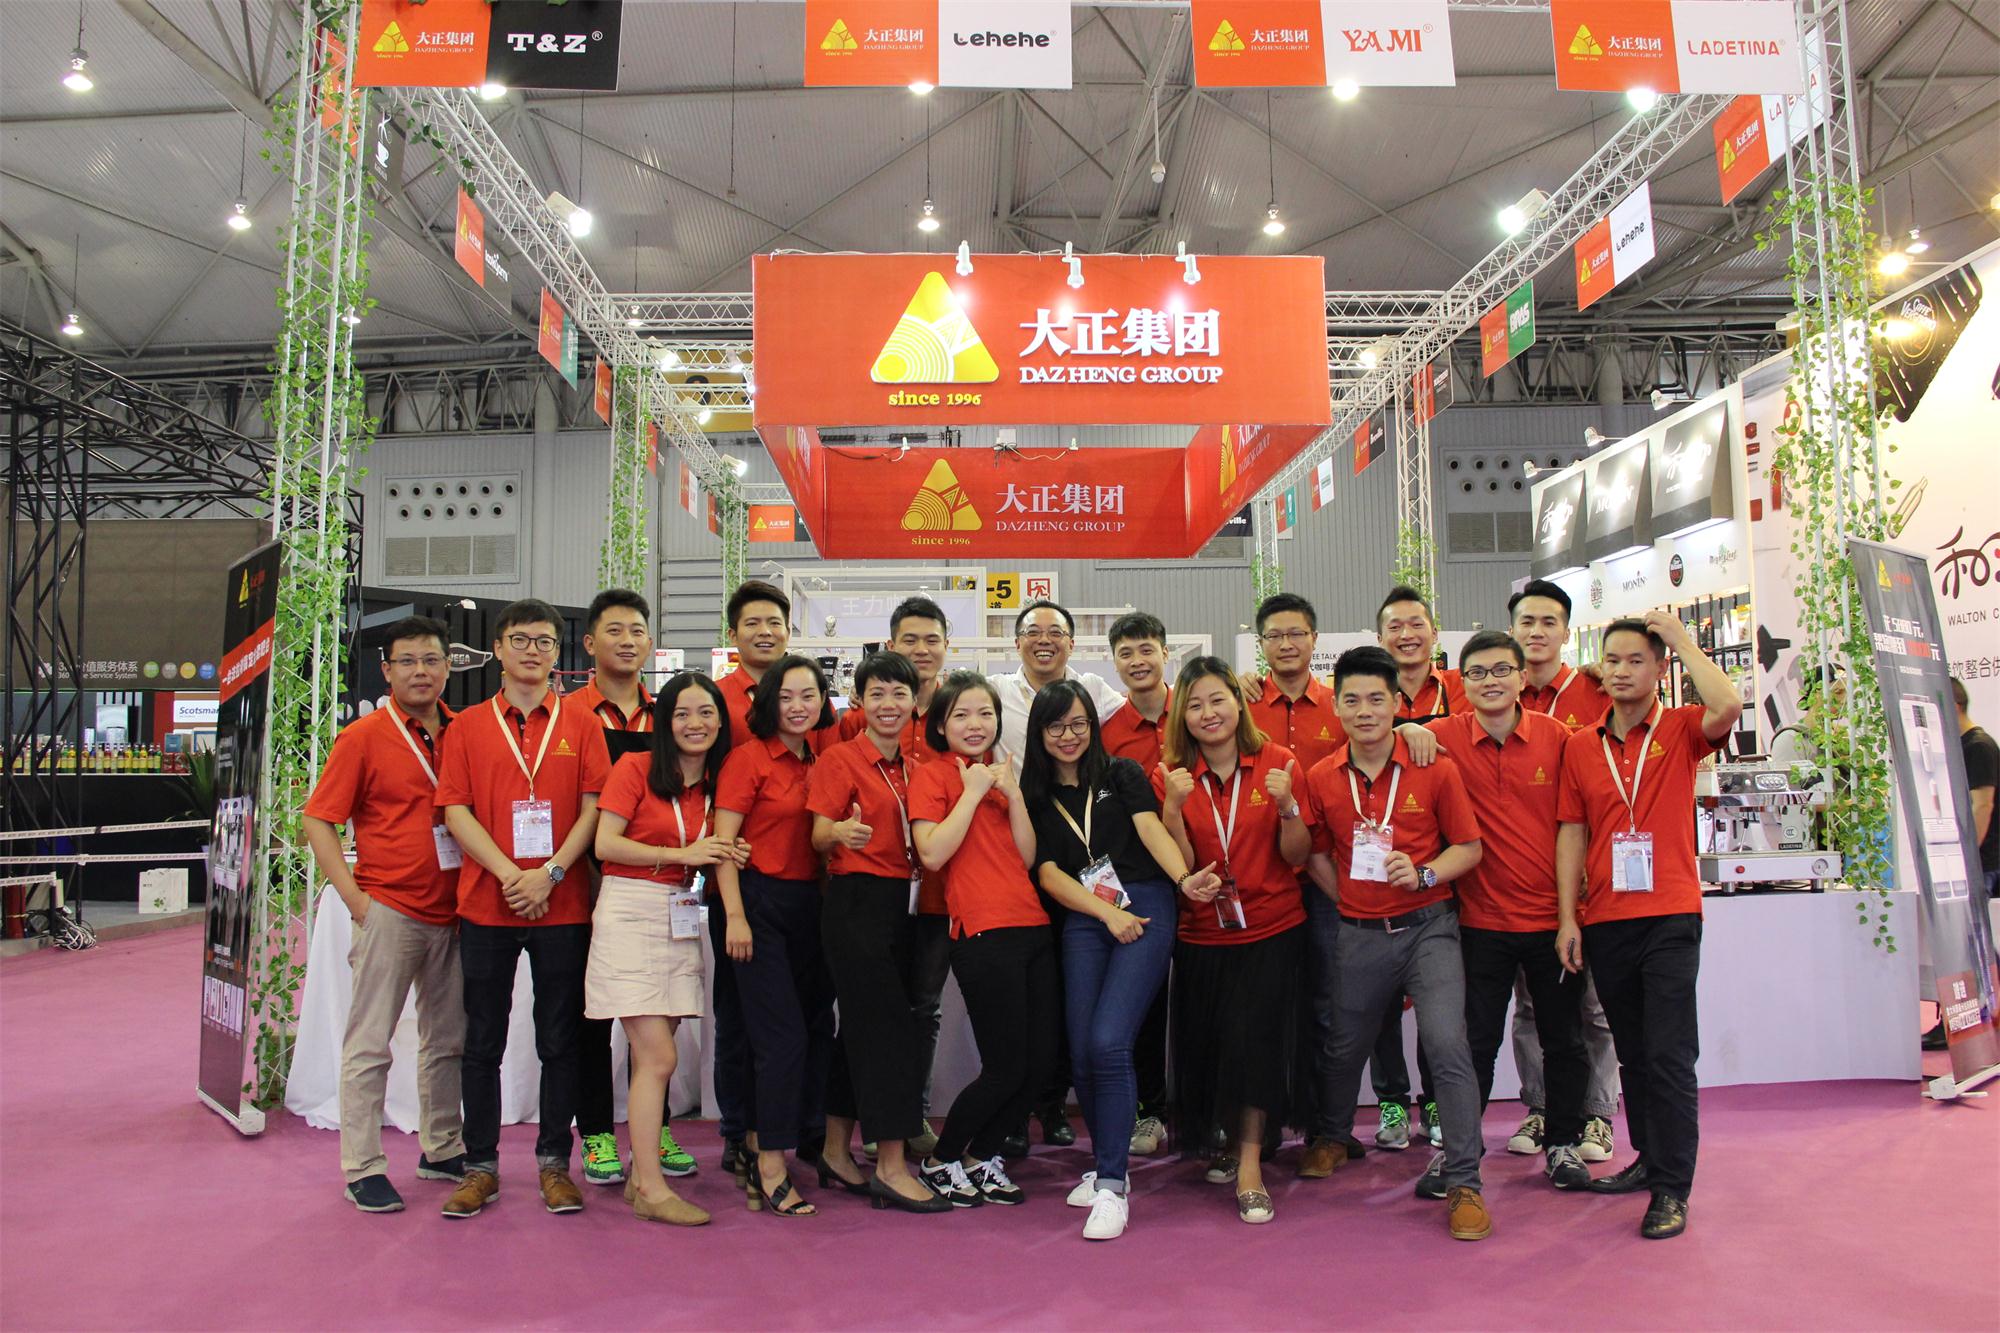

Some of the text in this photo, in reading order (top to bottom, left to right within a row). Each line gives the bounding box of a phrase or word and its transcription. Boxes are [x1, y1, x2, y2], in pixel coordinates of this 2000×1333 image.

[415, 31, 475, 46] 大正集团
[507, 33, 587, 53] T&Z
[864, 28, 924, 43] 大正集团
[953, 31, 1050, 47] Lehehe
[1250, 29, 1309, 43] 大正集团
[1608, 36, 1662, 51] 大正集团
[1687, 40, 1780, 56] LADETINA
[1019, 308, 1221, 357] 大正集团
[1141, 367, 1223, 384] GROUP
[888, 390, 981, 406] since 1996
[995, 483, 1124, 516] 大正集团
[996, 521, 1125, 532] DAZHENG GROUP
[911, 536, 945, 545] since
[1948, 609, 1987, 627] WALTON
[114, 672, 138, 680] System
[1947, 656, 2000, 681] 饮整合供
